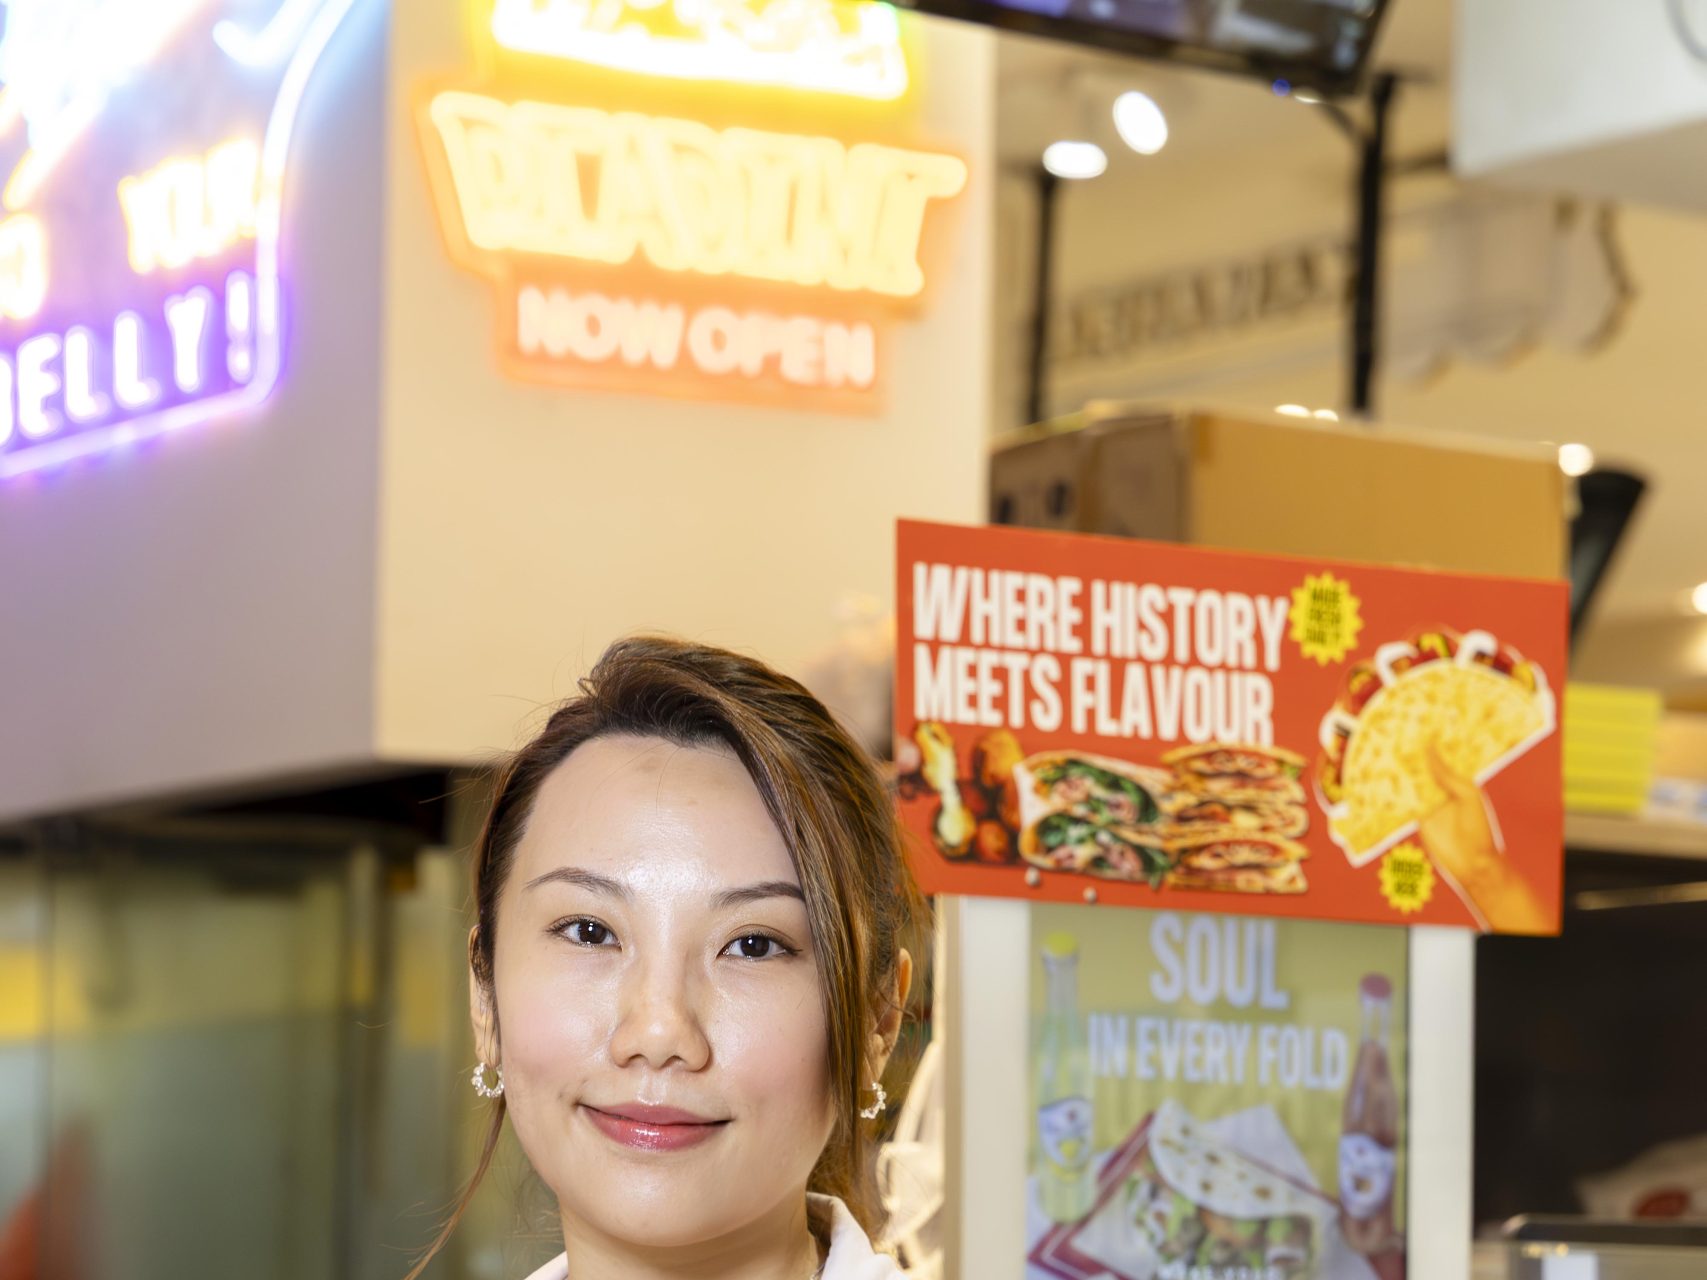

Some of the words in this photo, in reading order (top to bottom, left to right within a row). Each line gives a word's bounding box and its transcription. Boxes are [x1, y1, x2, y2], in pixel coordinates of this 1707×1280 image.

[0, 270, 253, 447] ELLY!
[518, 286, 684, 368] NOW
[688, 307, 876, 387] OPEN
[912, 561, 1083, 655] WHERE
[1091, 578, 1290, 673] HISTORY
[912, 643, 1064, 733] MEETS
[1070, 656, 1275, 748] FLAVOUR
[1149, 911, 1290, 1010] SOUL
[1088, 1011, 1127, 1080] IN
[1134, 1015, 1252, 1085] EVERY
[1258, 1026, 1349, 1091] FOLD
